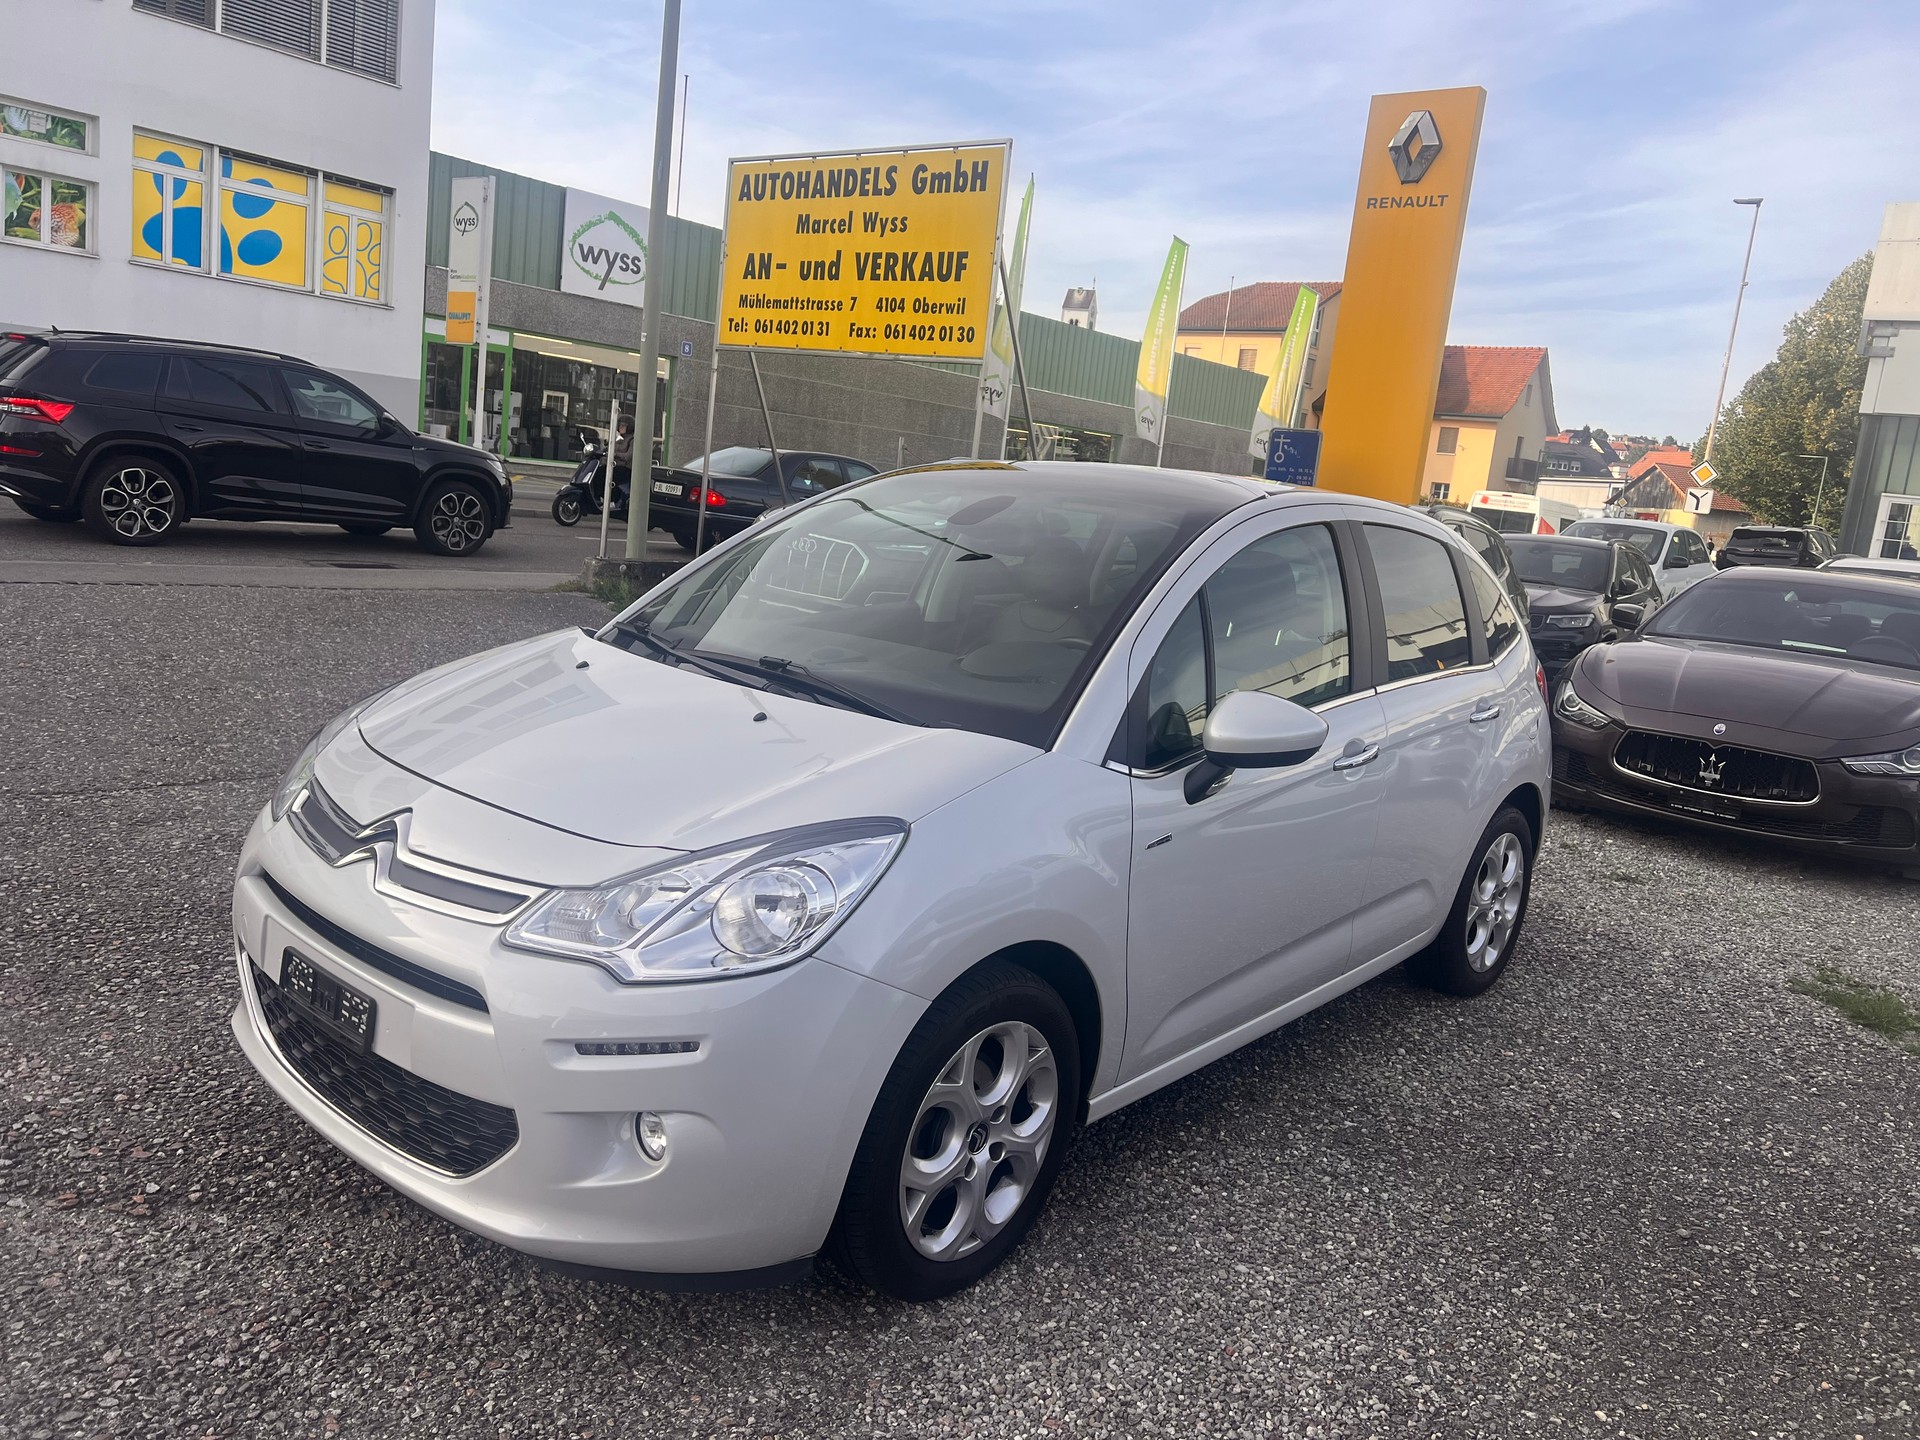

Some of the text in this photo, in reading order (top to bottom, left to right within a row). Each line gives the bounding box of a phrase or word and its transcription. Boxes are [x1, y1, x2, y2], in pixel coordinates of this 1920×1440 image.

[738, 159, 989, 201] AUTOHANDELS GmbH
[1367, 195, 1448, 209] RENAULT
[455, 217, 476, 237] wyss
[796, 211, 908, 238] Marcel Wyss
[578, 243, 642, 291] wyss
[799, 250, 842, 281] und
[855, 251, 969, 282] VERKAUF
[738, 293, 966, 315] Mühlemattstrasse 7 4104 Oberwil
[728, 317, 748, 333] Tel:
[849, 322, 877, 339] Fax:
